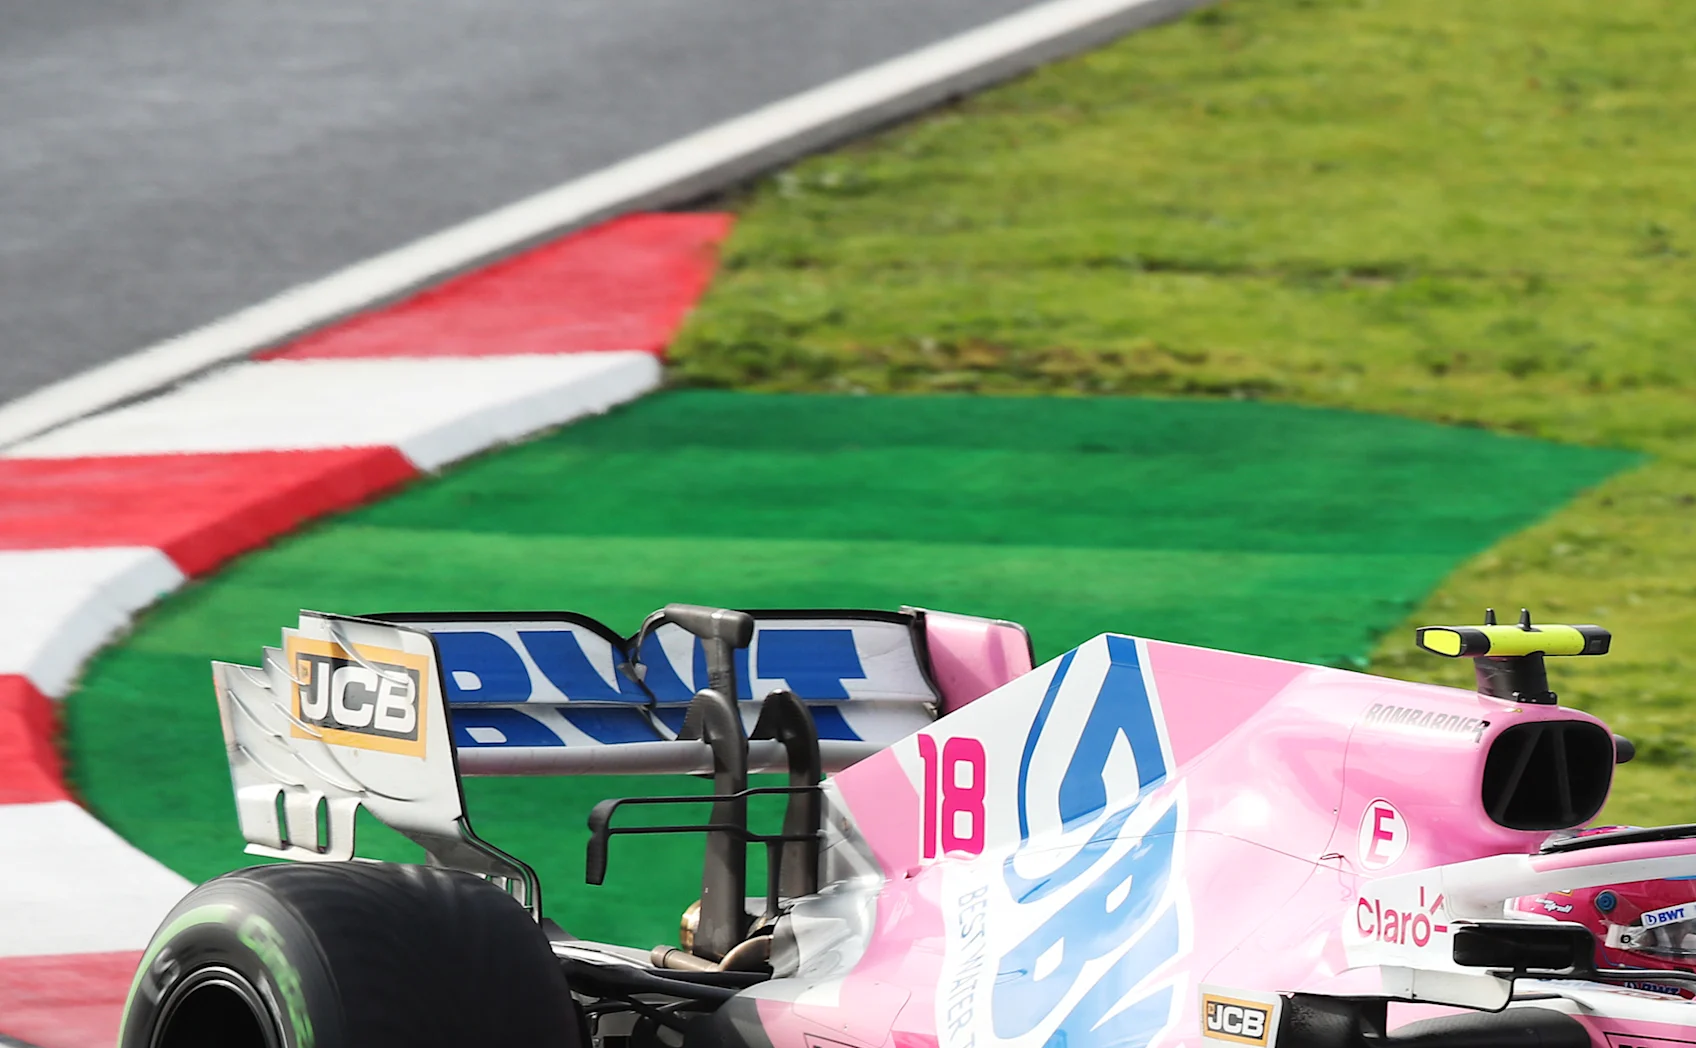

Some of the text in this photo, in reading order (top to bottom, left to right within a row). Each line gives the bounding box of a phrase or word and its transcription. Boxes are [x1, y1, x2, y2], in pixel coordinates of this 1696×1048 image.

[299, 661, 417, 734] JCB
[434, 630, 867, 747] BWT
[1366, 703, 1491, 744] BOMBARDIER
[917, 733, 986, 860] 18
[1366, 807, 1394, 865] E
[1356, 893, 1434, 948] Claro
[1658, 908, 1685, 923] BWT
[1207, 1004, 1265, 1038] JCB
